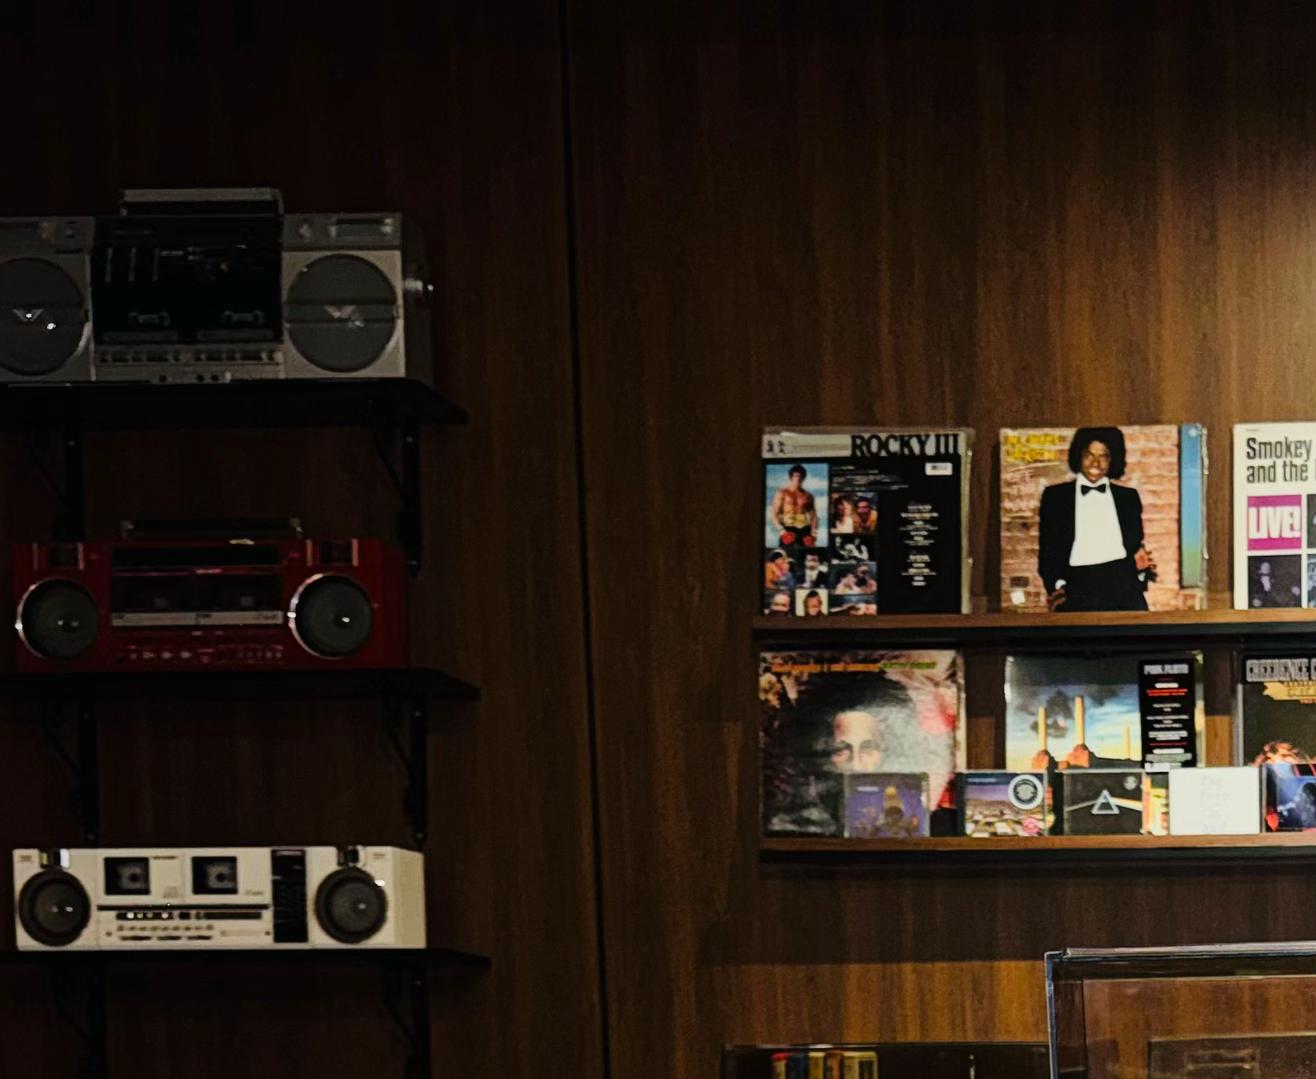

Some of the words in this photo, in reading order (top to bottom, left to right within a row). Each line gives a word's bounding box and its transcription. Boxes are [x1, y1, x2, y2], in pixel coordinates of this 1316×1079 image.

[851, 434, 930, 457] ROCKY
[935, 433, 961, 456] III
[1246, 437, 1312, 462] Smokey
[1246, 461, 1276, 484] and
[1283, 460, 1308, 482] the
[1248, 506, 1301, 539] LIVE!
